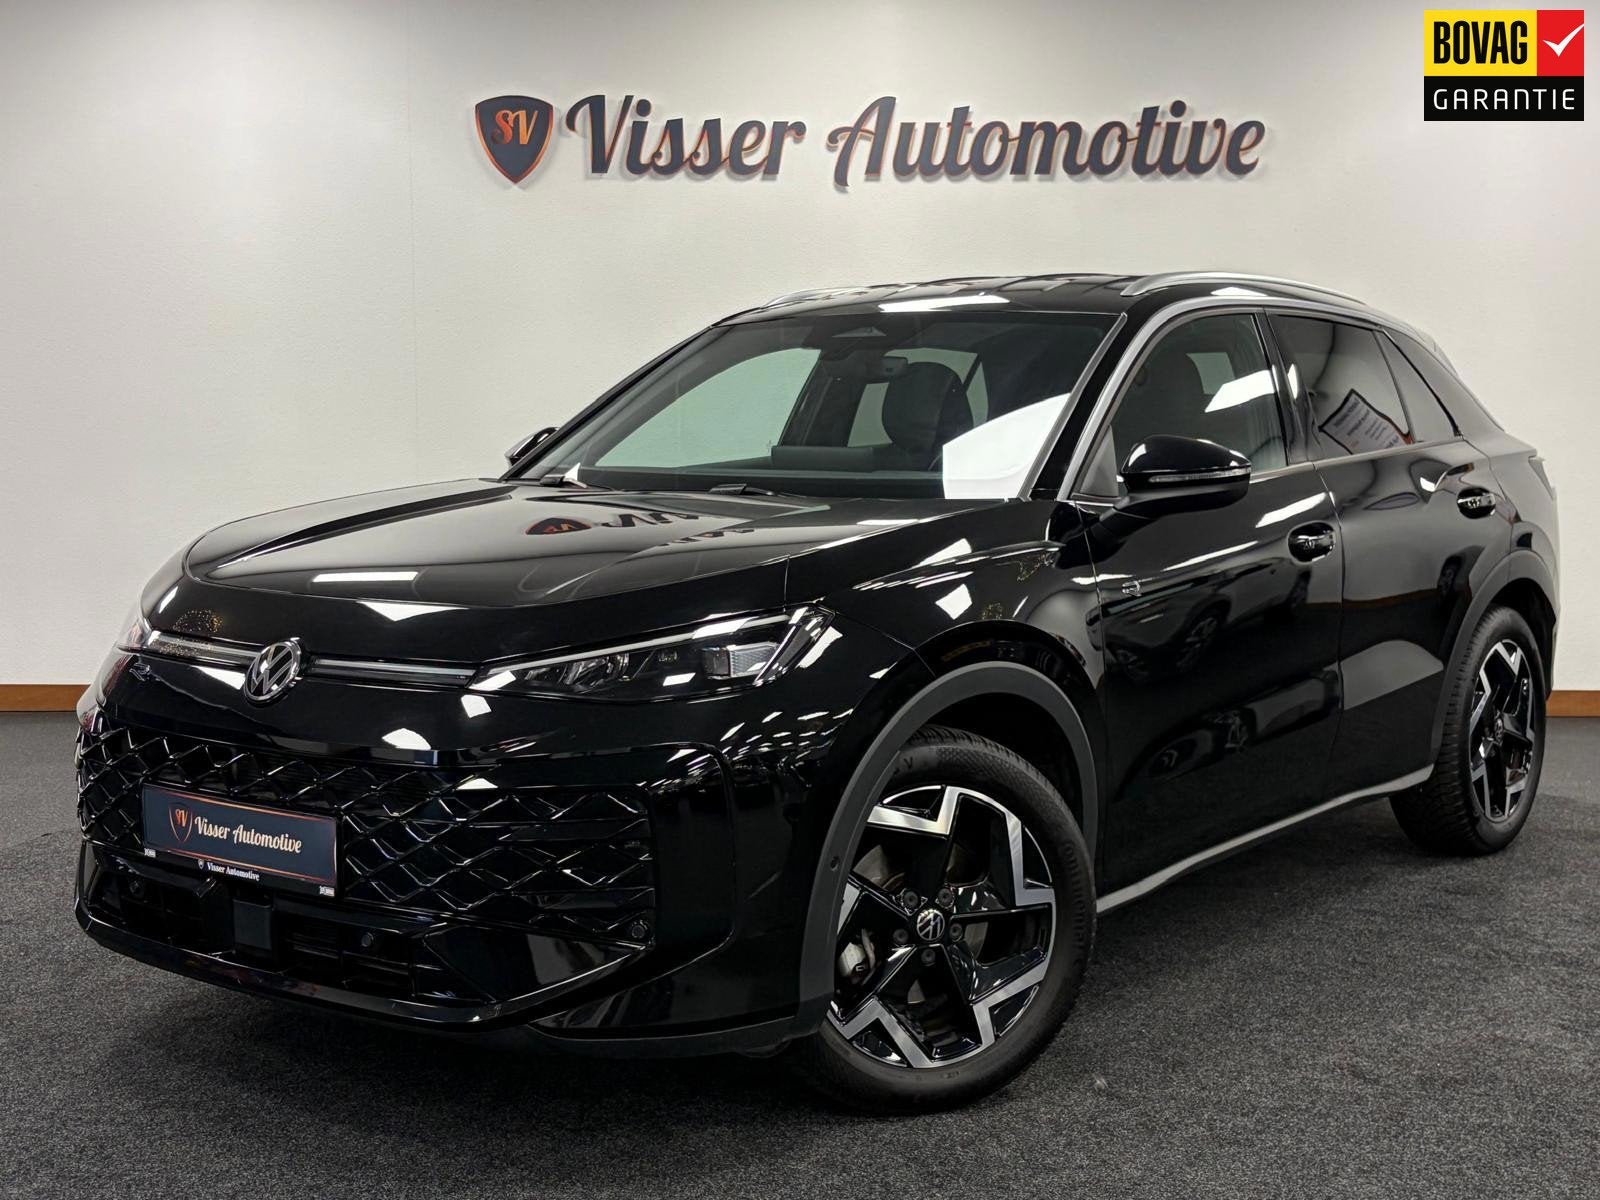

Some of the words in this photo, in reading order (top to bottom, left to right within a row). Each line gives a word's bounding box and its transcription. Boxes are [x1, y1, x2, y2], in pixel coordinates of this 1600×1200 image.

[491, 109, 538, 145] SV
[565, 94, 807, 176] Visser
[826, 96, 1267, 188] Automotive
[195, 816, 230, 840] Visser
[233, 824, 302, 854] Automotive
[207, 861, 225, 873] Visser
[225, 866, 260, 881] Automotive
